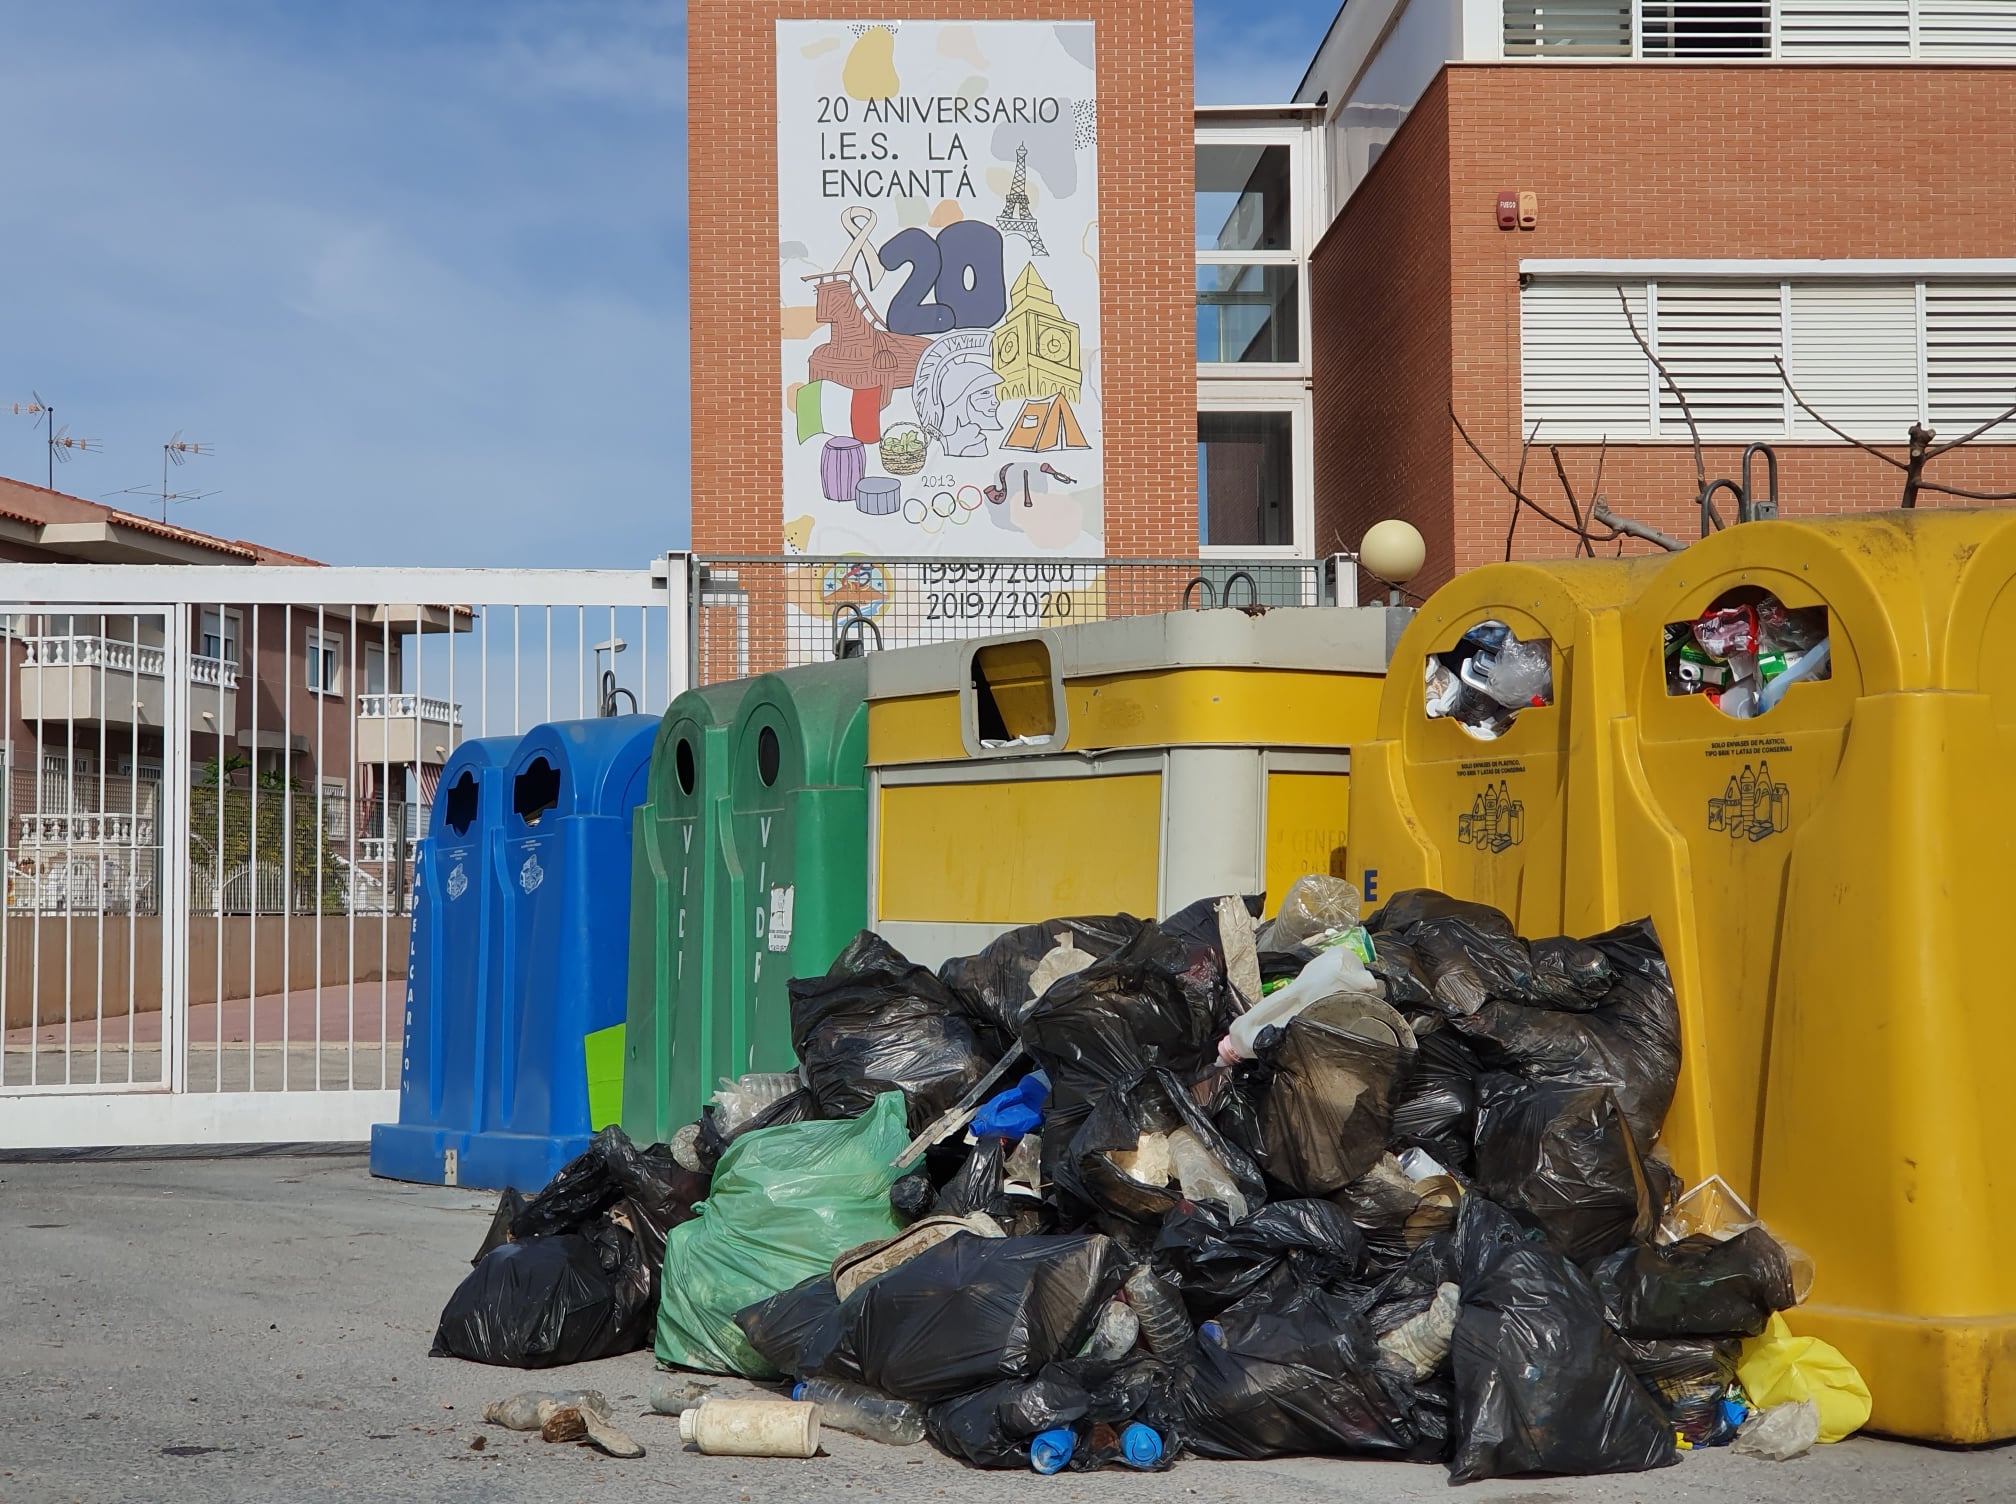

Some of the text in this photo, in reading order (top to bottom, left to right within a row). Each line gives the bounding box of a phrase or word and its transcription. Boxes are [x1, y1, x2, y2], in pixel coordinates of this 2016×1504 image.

[817, 97, 1060, 124] 20 ANIVERSARIO
[821, 132, 968, 161] I.E.S. LA
[822, 164, 976, 198] ENCANTÁ
[1500, 200, 1517, 209] FUEGO
[878, 219, 1007, 336] 20
[920, 474, 956, 489] 2013
[923, 563, 1074, 585] 1999/2000
[926, 591, 1071, 620] 2019/2020
